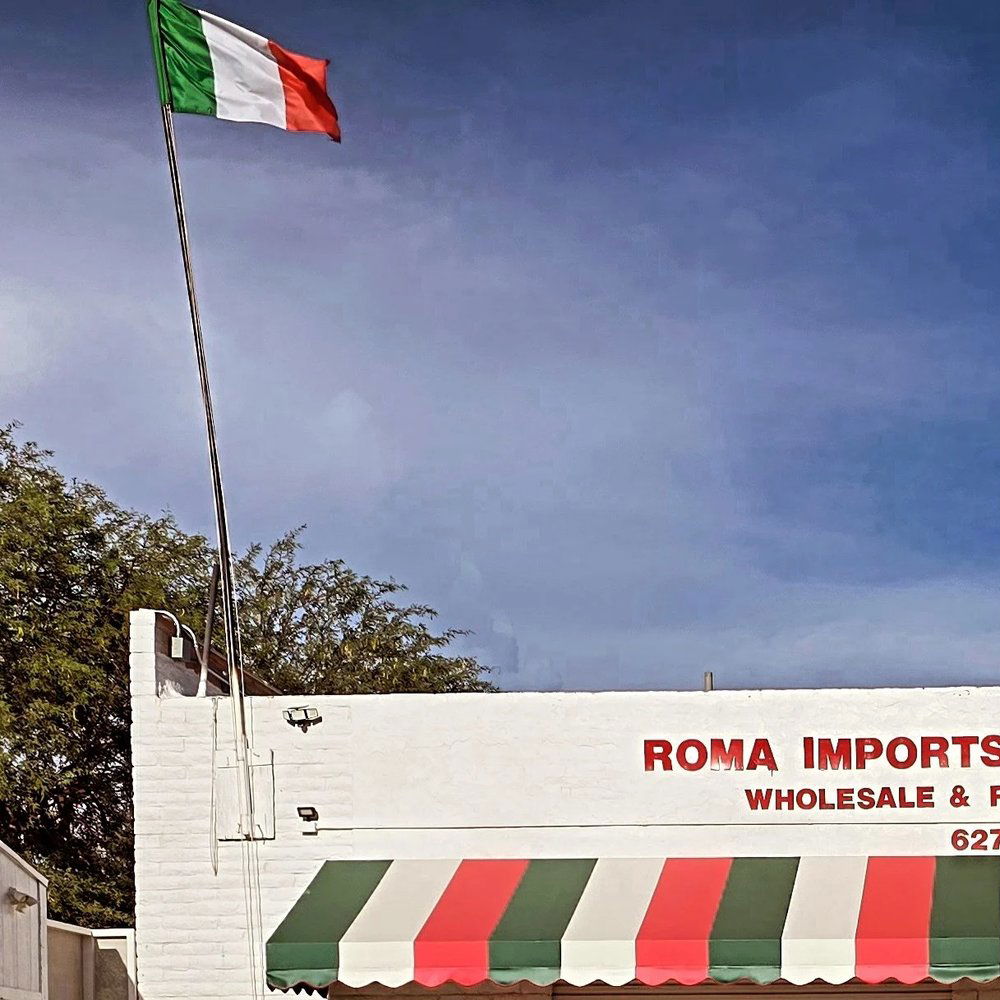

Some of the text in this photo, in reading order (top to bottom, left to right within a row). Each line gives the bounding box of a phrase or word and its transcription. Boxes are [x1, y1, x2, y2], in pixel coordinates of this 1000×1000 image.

[643, 738, 778, 772] ROMA
[744, 786, 935, 811] WHOLESALE
[949, 785, 970, 808] &
